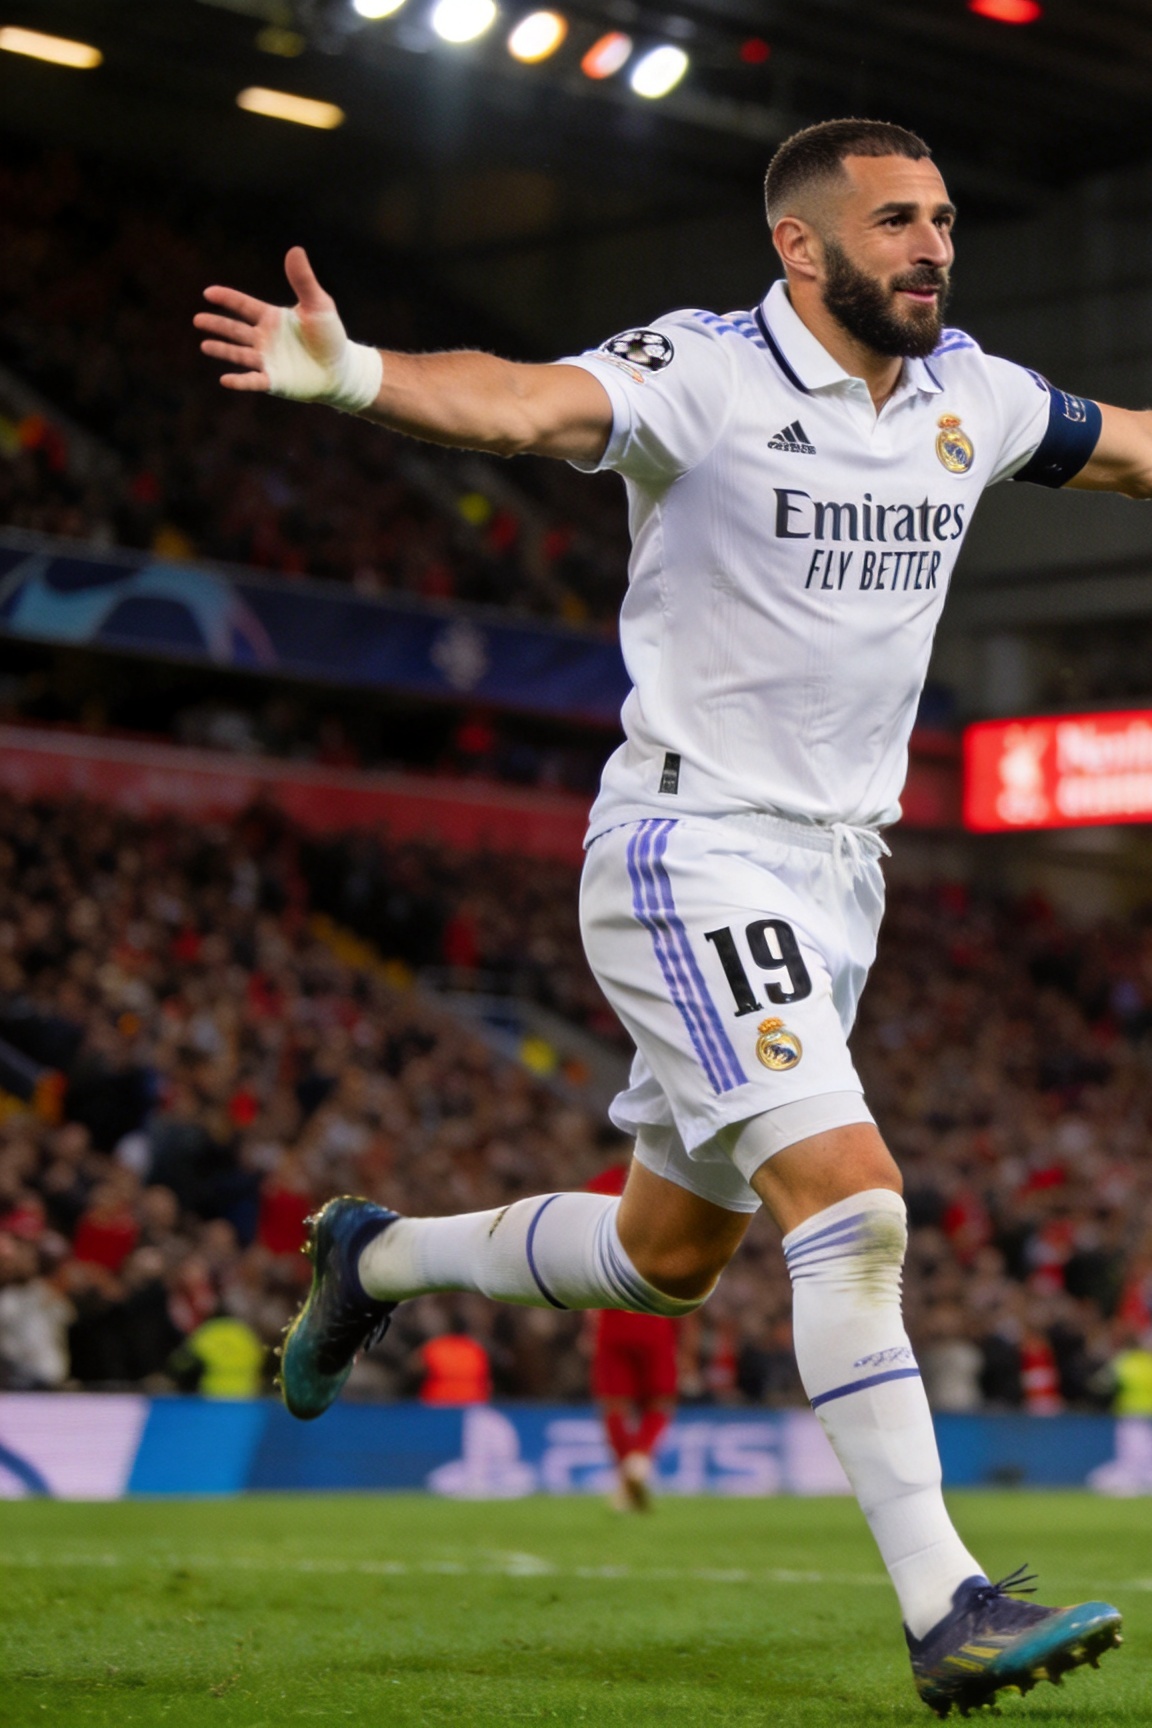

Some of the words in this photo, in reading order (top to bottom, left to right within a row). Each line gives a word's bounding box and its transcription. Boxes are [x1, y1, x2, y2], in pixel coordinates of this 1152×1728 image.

[773, 488, 965, 542] Emirates
[804, 549, 853, 591] FLY
[858, 550, 942, 591] BETTER
[704, 918, 812, 1017] 19
